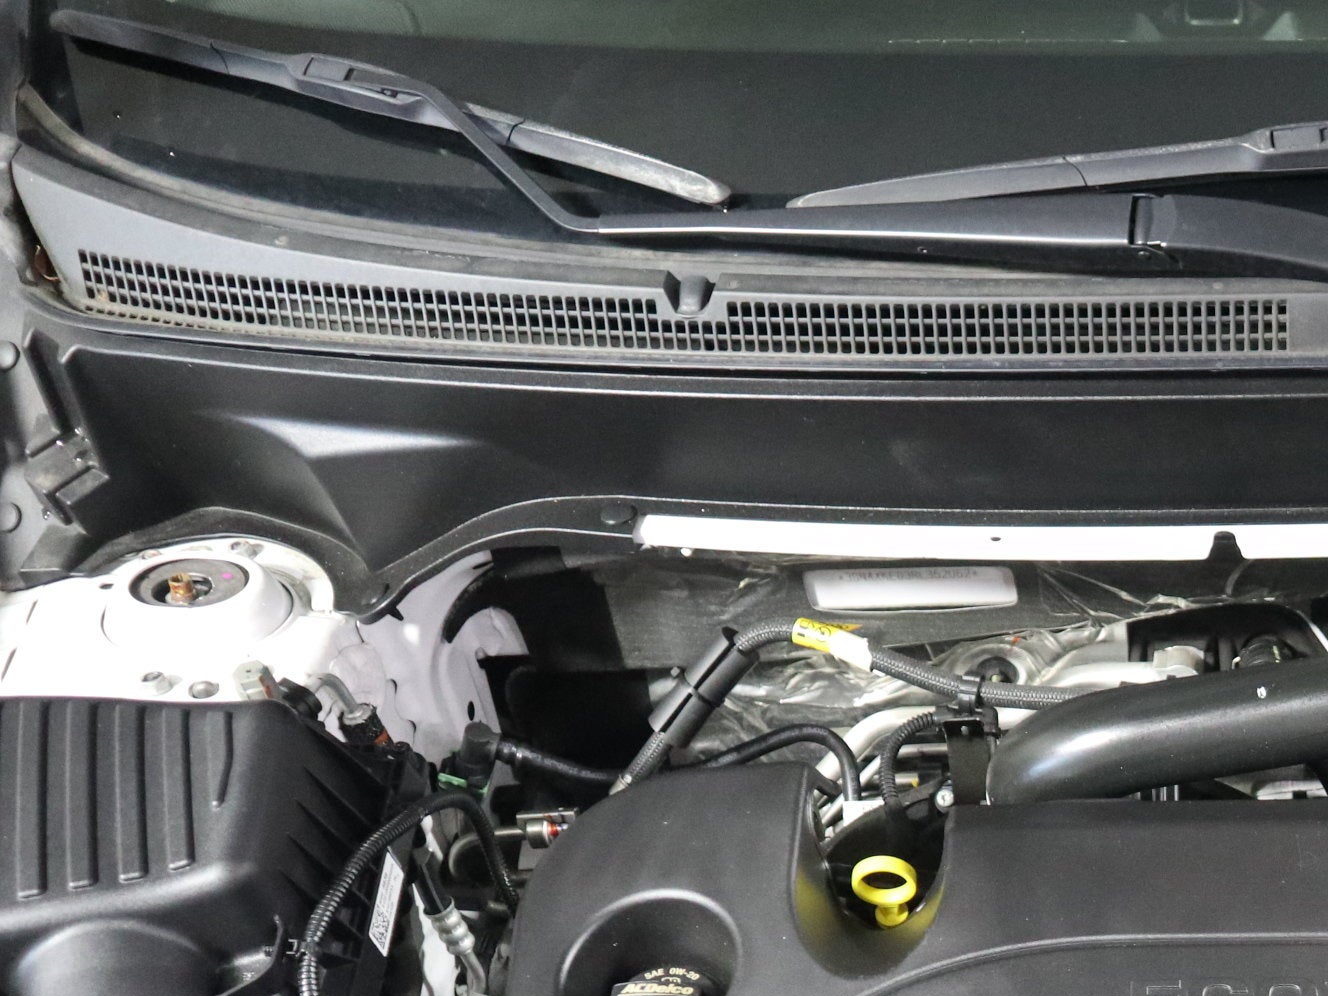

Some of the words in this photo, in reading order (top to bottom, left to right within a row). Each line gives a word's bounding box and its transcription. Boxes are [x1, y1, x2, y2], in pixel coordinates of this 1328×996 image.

[644, 968, 664, 980] SAE
[669, 967, 700, 981] 0W-20
[621, 983, 694, 996] ACDelco
